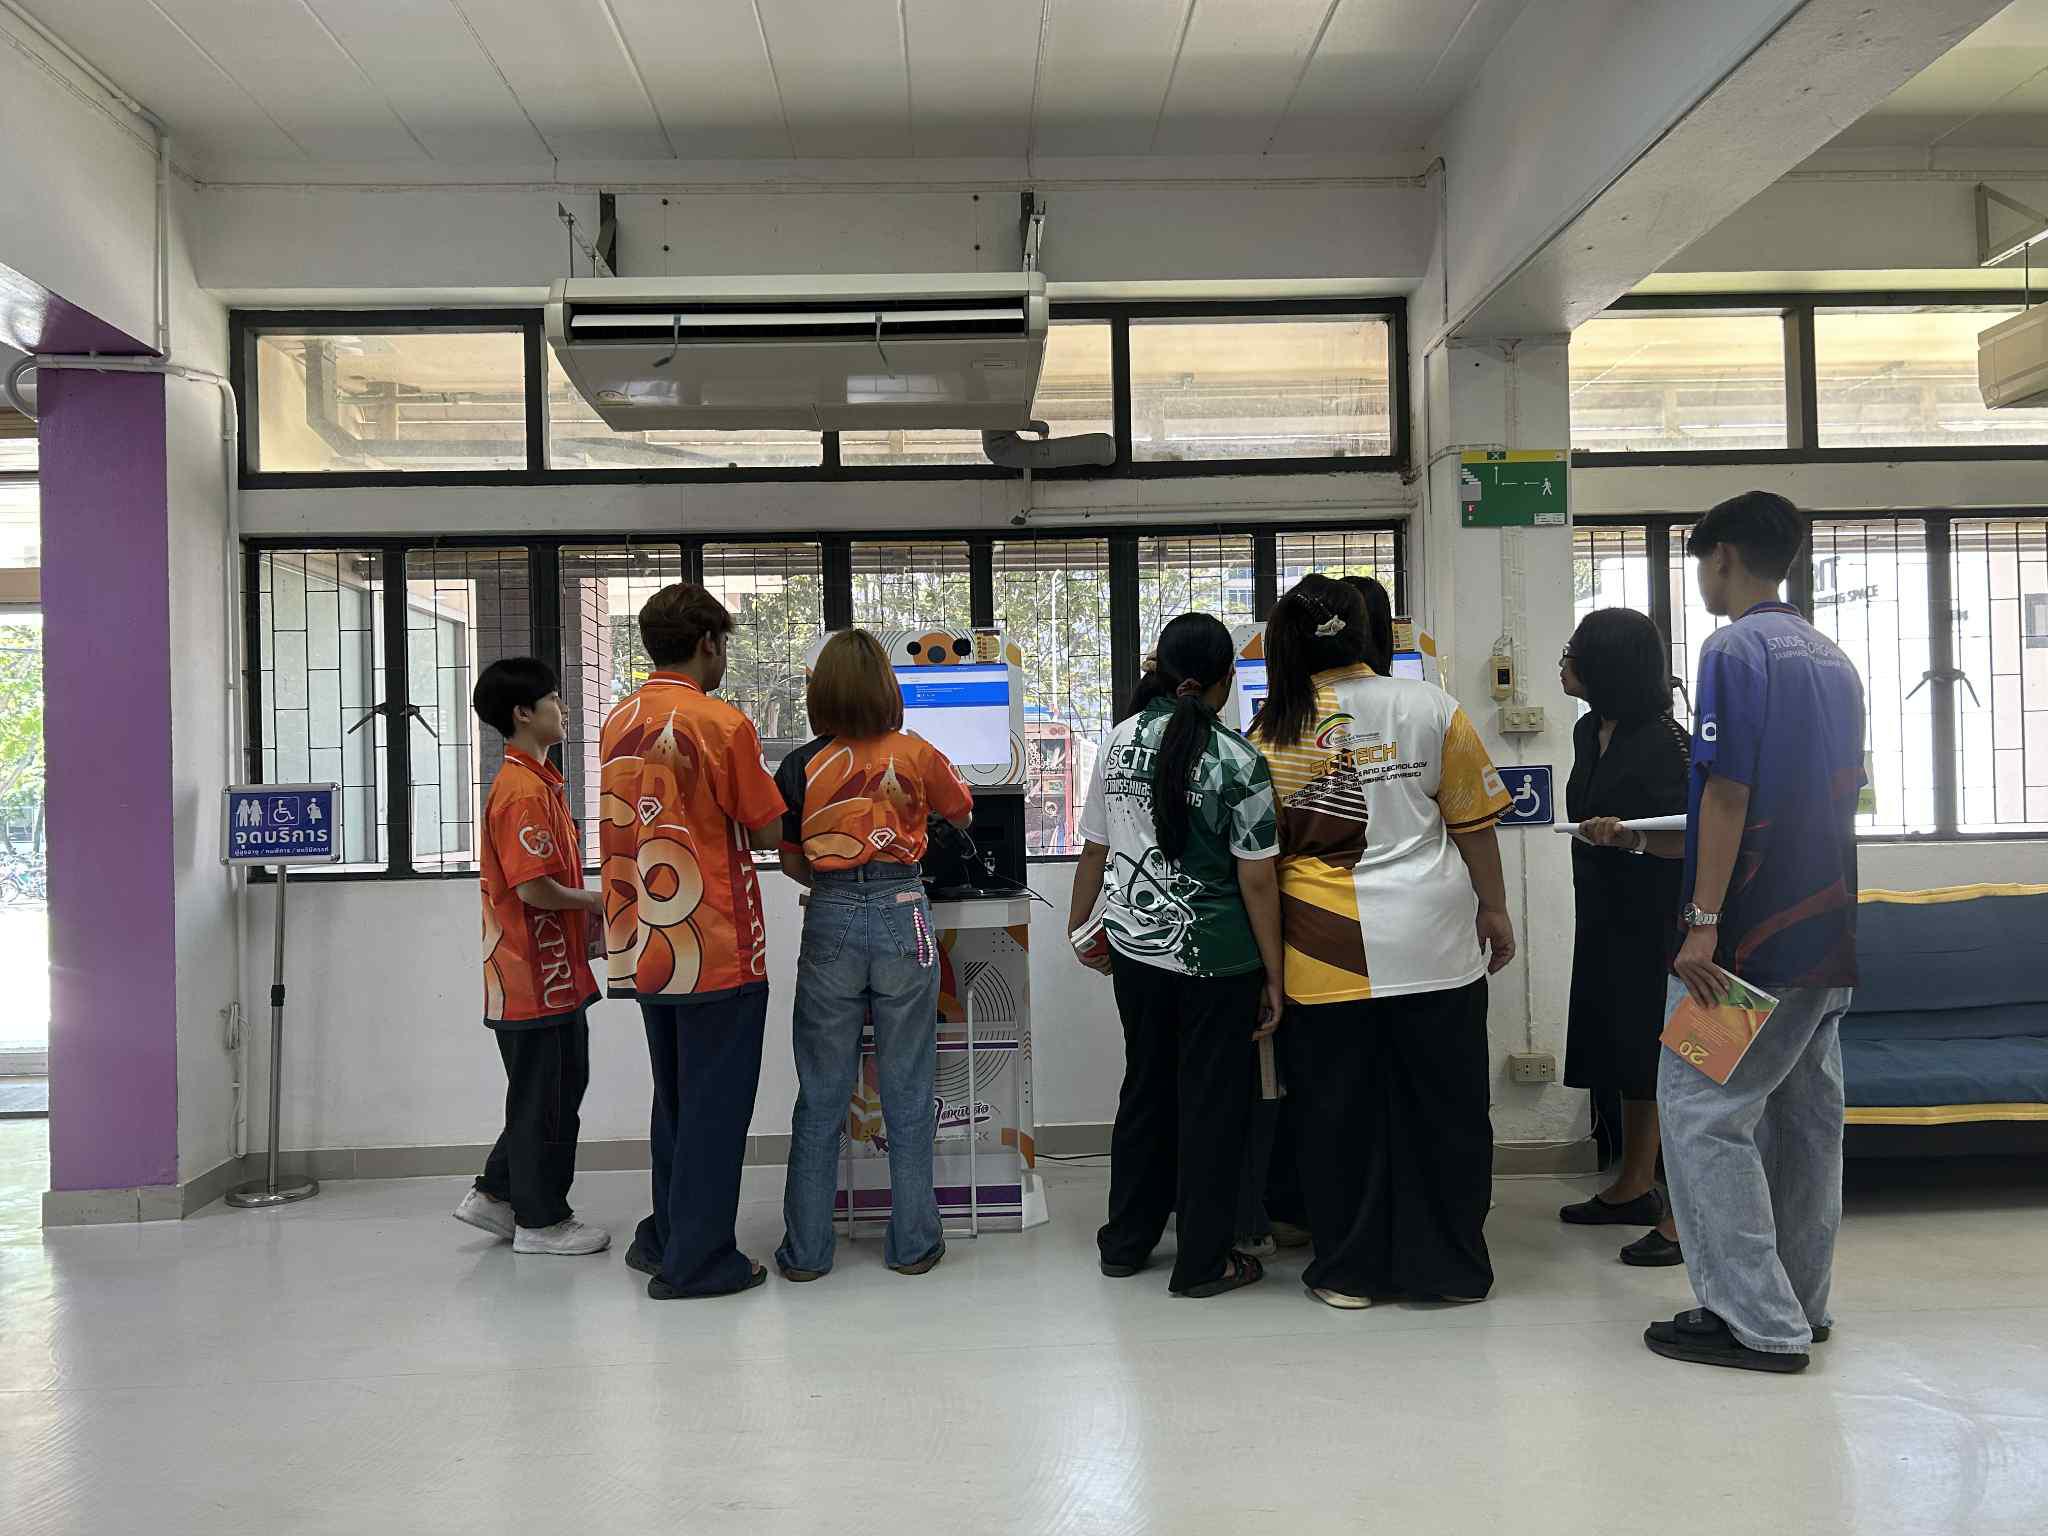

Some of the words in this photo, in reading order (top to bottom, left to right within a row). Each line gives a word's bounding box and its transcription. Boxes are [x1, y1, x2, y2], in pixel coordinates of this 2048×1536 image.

[235, 827, 328, 850] จุดบริการ
[534, 912, 576, 1009] KPRU
[1679, 1040, 1711, 1066] 20
